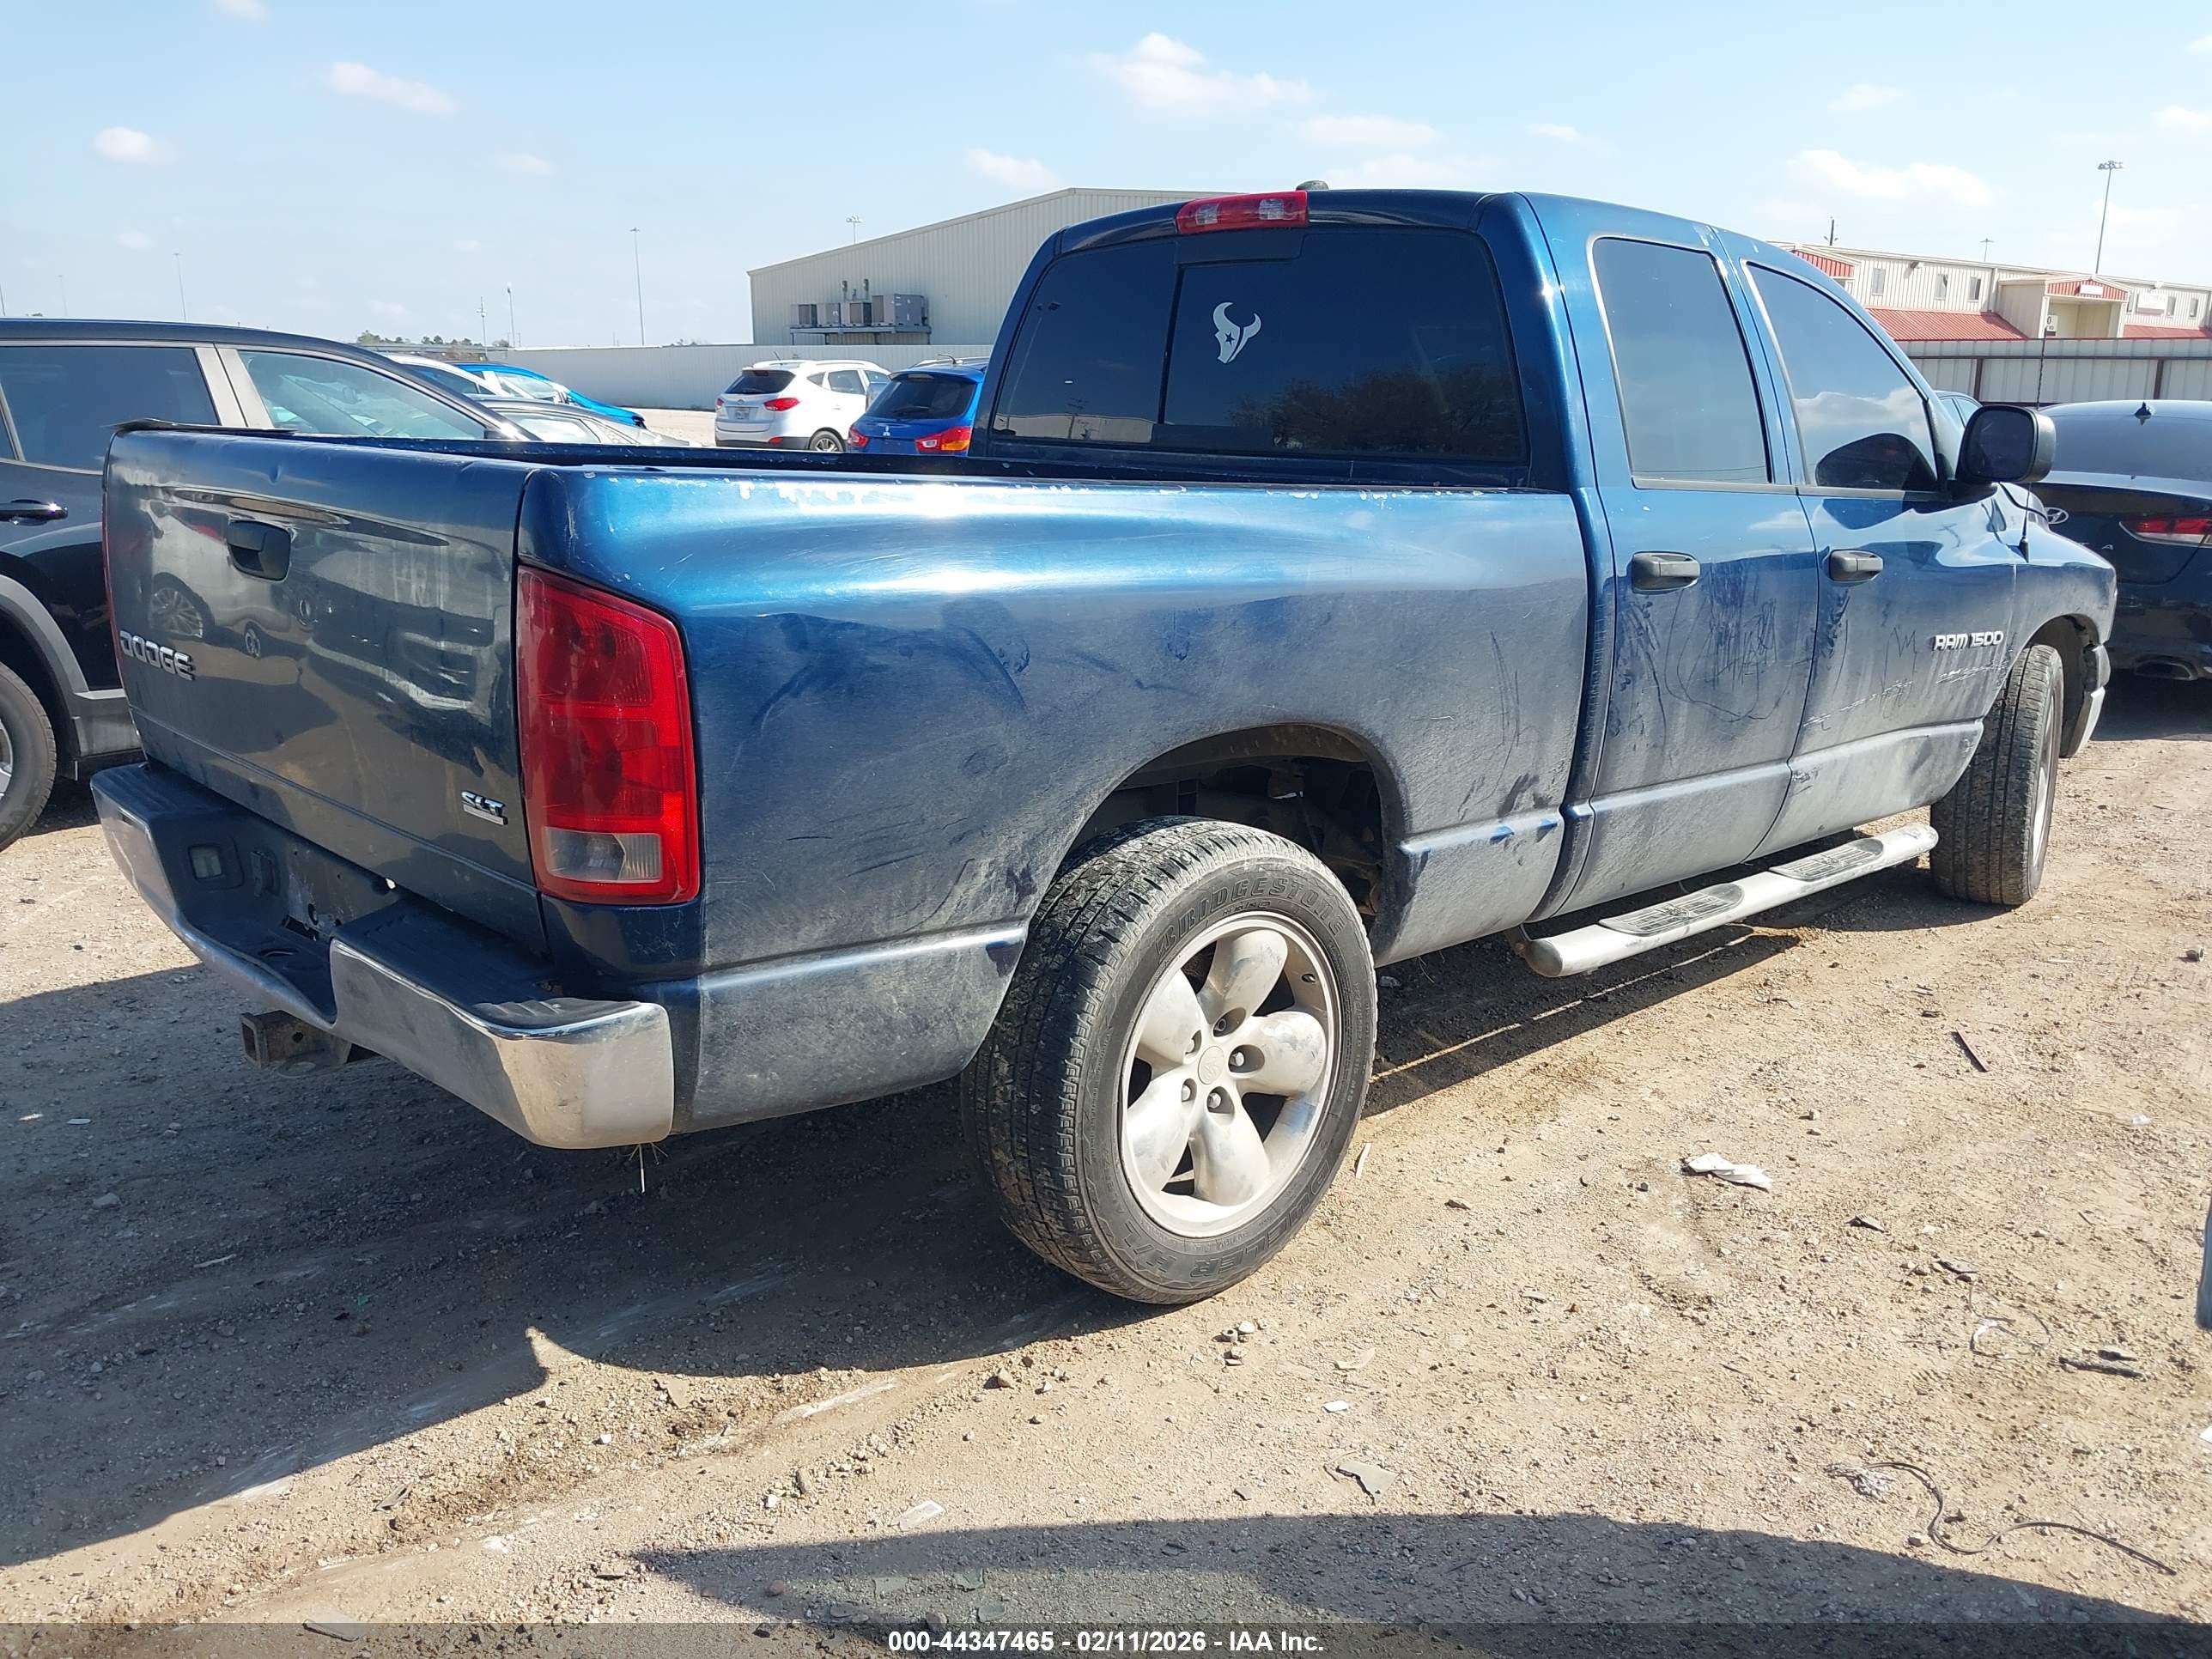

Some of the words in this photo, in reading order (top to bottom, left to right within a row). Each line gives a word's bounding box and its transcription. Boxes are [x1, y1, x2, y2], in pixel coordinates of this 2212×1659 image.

[118, 629, 194, 681] DODGE
[1934, 634, 1968, 651] RAM
[1970, 630, 2004, 648] 1500
[460, 791, 505, 817] SLT
[1155, 877, 1346, 956] BRIDGESTONE
[1190, 1159, 1331, 1278] DUELER
